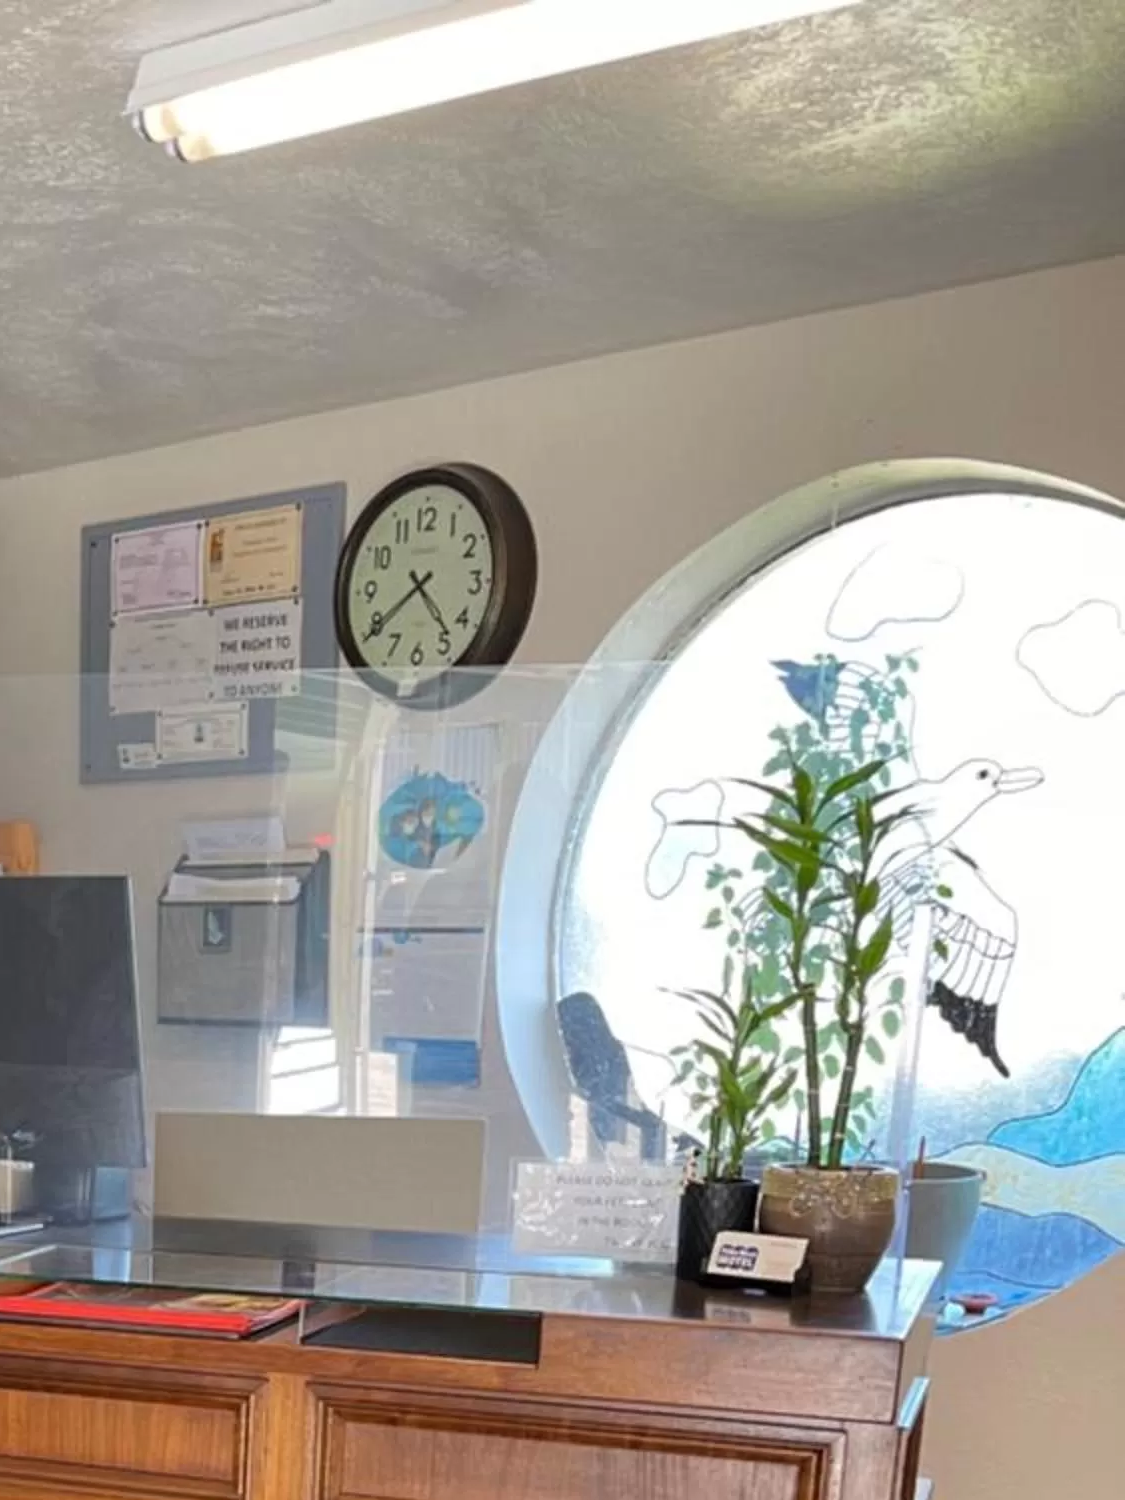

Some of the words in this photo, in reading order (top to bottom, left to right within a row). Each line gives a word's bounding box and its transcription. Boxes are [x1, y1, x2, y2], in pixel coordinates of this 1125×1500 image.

[395, 518, 409, 544] 11
[416, 507, 437, 532] 12
[450, 512, 456, 537] 1
[375, 545, 391, 570] 10
[462, 533, 477, 558] 2
[364, 580, 377, 604] 9
[467, 569, 482, 595] 3
[371, 611, 384, 636] 8
[455, 606, 469, 629] 4
[241, 637, 273, 652] RIGHT
[275, 635, 291, 649] TO
[388, 632, 402, 657] 7
[410, 642, 424, 666] 6
[436, 630, 451, 655] 5
